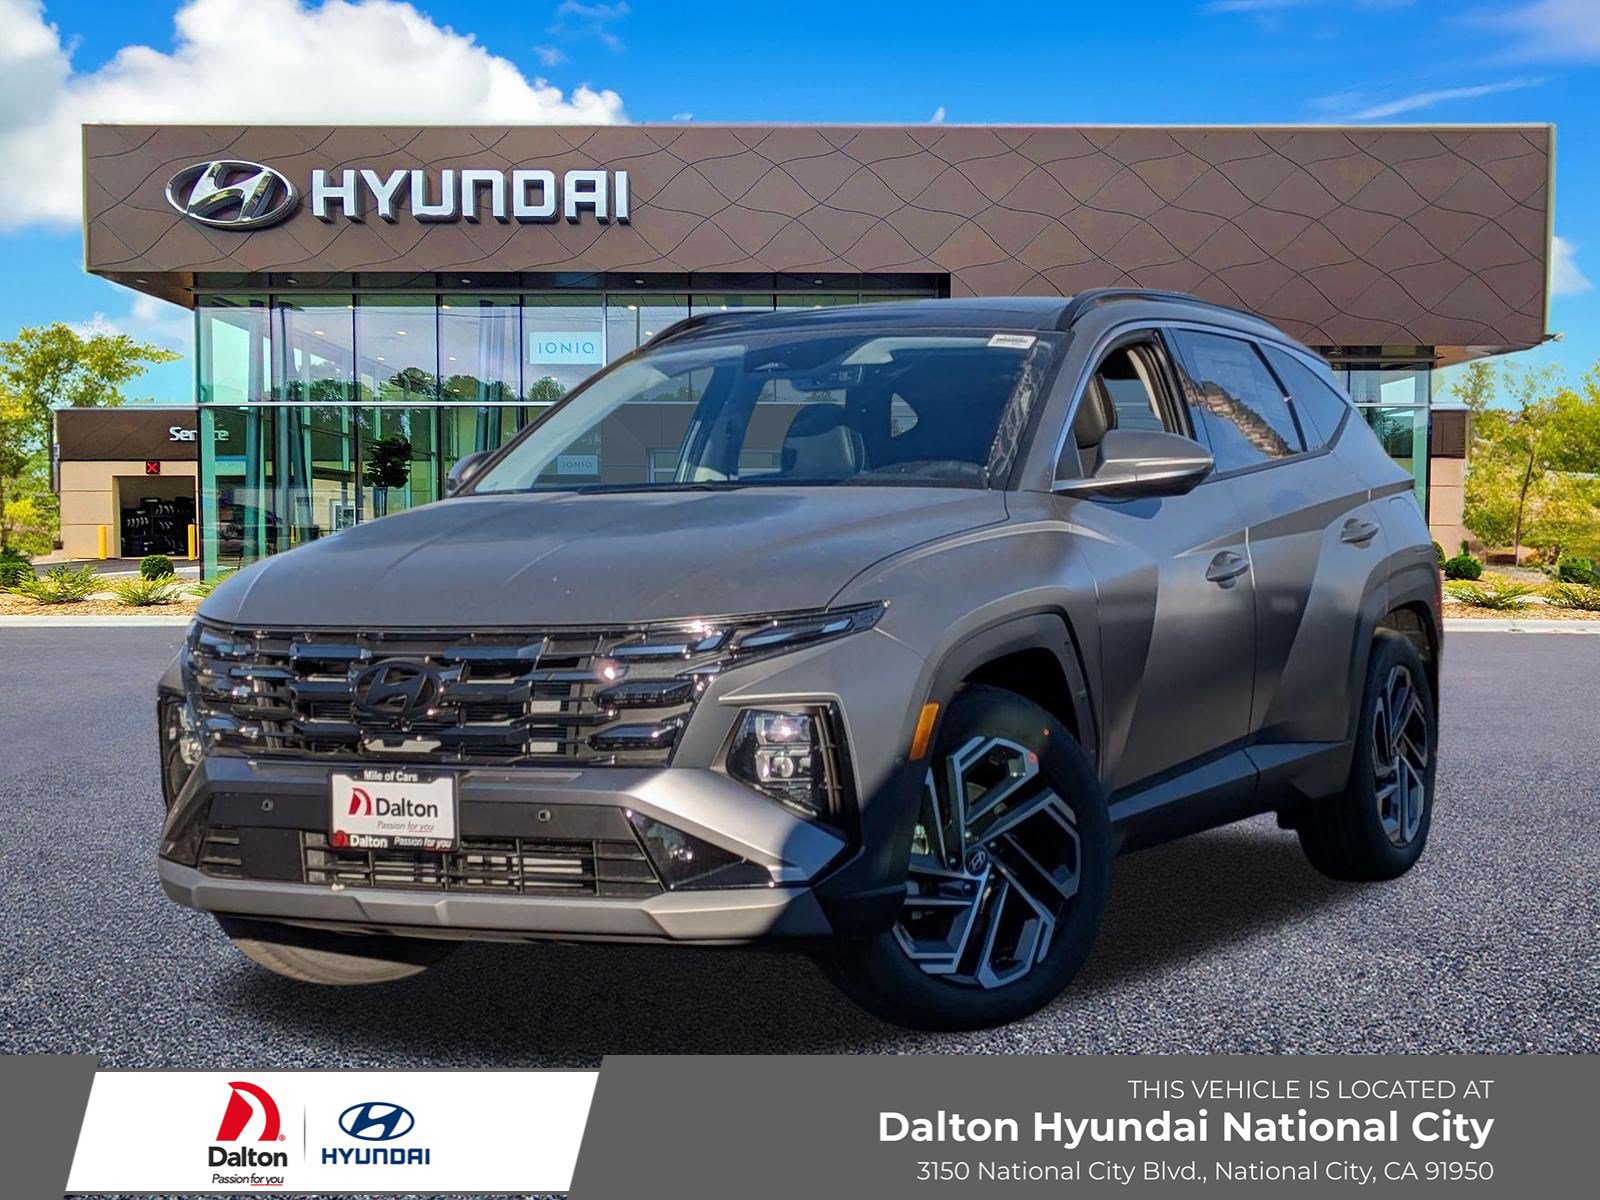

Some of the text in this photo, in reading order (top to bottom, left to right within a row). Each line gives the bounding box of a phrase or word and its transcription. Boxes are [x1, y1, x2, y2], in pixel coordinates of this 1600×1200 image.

[311, 169, 630, 223] HYUNDAI
[538, 341, 595, 354] IONIQ
[169, 426, 230, 441] Serce
[363, 770, 419, 782] Mile of Cars
[375, 797, 439, 818] Dalton
[376, 821, 435, 833] Passion for you
[350, 834, 452, 849] Dalton Passion for you
